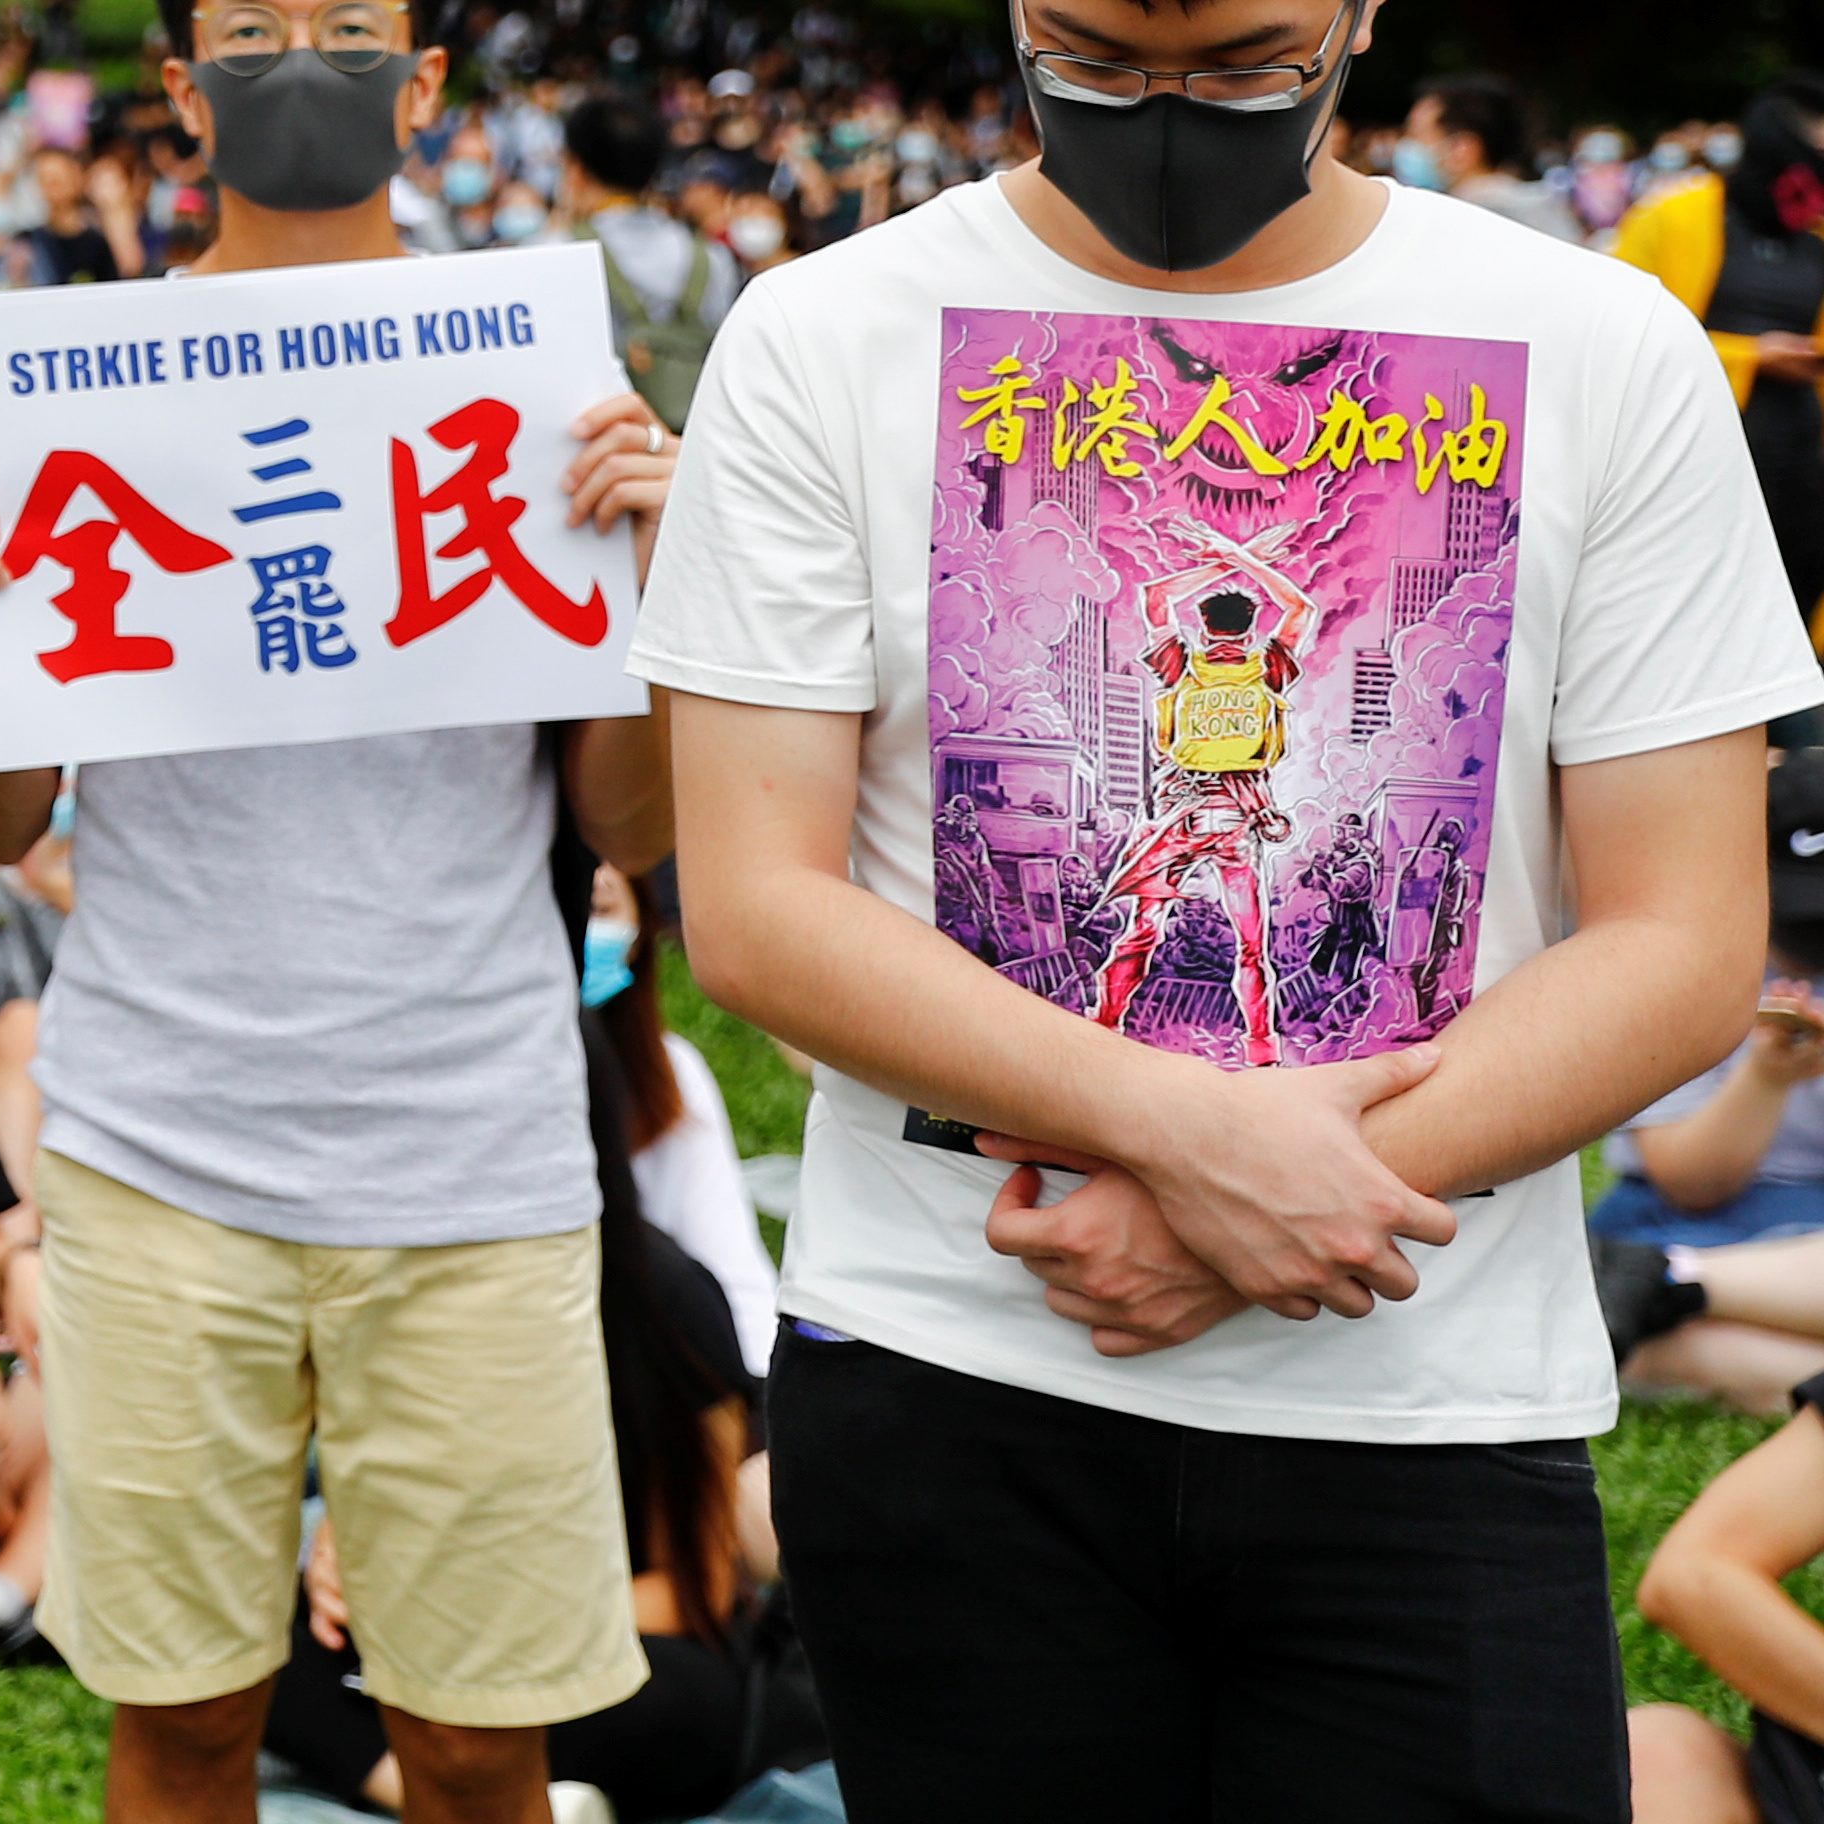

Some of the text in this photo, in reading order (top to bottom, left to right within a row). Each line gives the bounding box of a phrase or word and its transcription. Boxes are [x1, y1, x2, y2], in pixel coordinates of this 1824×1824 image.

[8, 303, 536, 397] STRKIE FOR HONG KONG
[956, 356, 1509, 495] 香港人加油
[2, 396, 610, 685] 全 三罷 民
[1191, 689, 1256, 712] HONG
[1191, 715, 1259, 737] KONG
